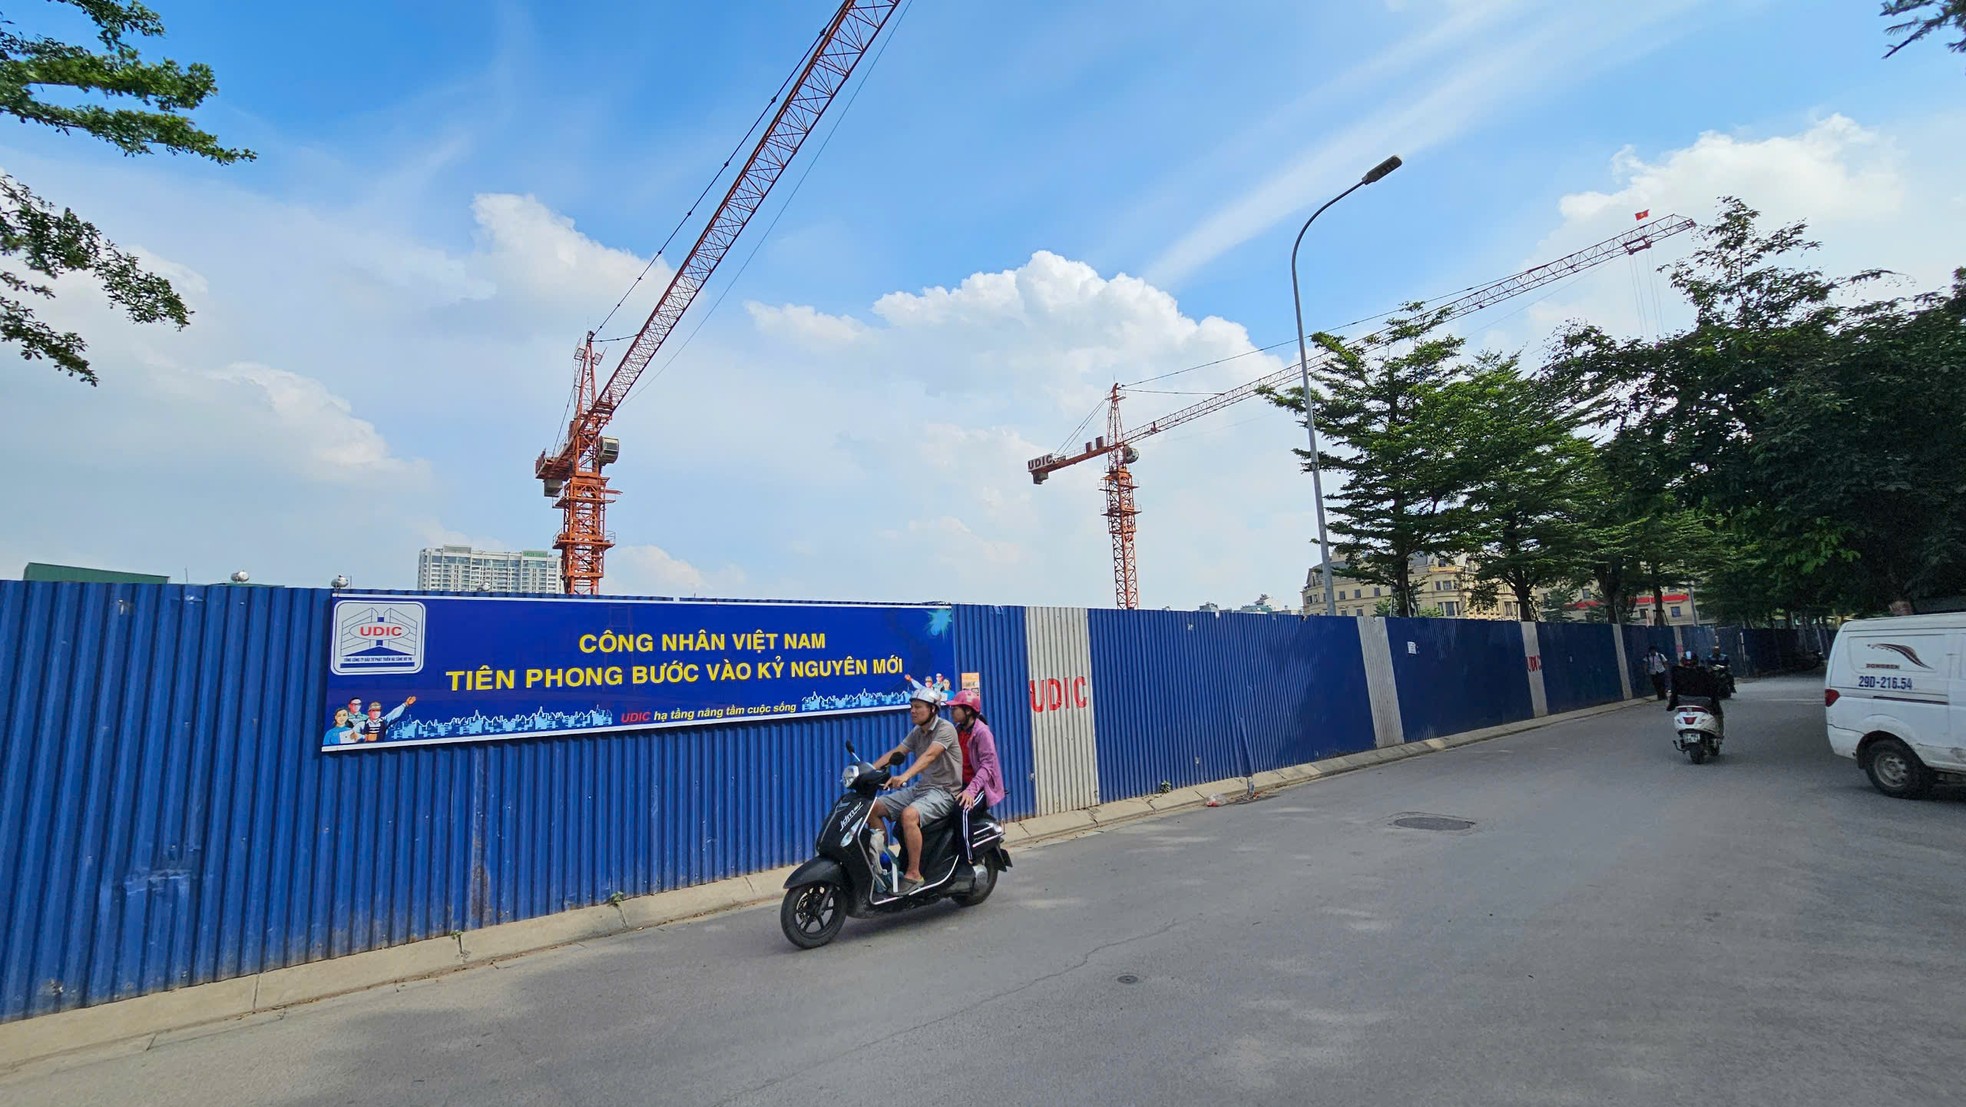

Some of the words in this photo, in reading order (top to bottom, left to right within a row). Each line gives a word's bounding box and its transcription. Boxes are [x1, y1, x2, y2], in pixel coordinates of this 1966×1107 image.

[1028, 454, 1053, 469] UDIC
[360, 626, 403, 637] UDIC
[579, 629, 653, 653] CÔNG
[661, 629, 725, 651] NHÂN
[732, 629, 778, 653] VIỆT
[784, 633, 826, 650] NAM
[445, 665, 515, 691] TIÊN
[525, 666, 623, 689] PHONG
[632, 660, 699, 684] BƯỚC
[706, 658, 751, 681] VÀO
[757, 655, 785, 679] KỶ
[791, 656, 867, 677] NGUYÊN
[873, 654, 903, 674] MỚI
[1858, 675, 1913, 690] 29D-216.54
[1029, 676, 1087, 713] UDIC
[621, 711, 651, 723] UDIC
[653, 711, 668, 723] hạ
[670, 707, 694, 720] tầng
[697, 707, 723, 718] nâng
[726, 704, 745, 715] tầm
[747, 704, 770, 715] cuộc
[773, 701, 796, 713] sống
